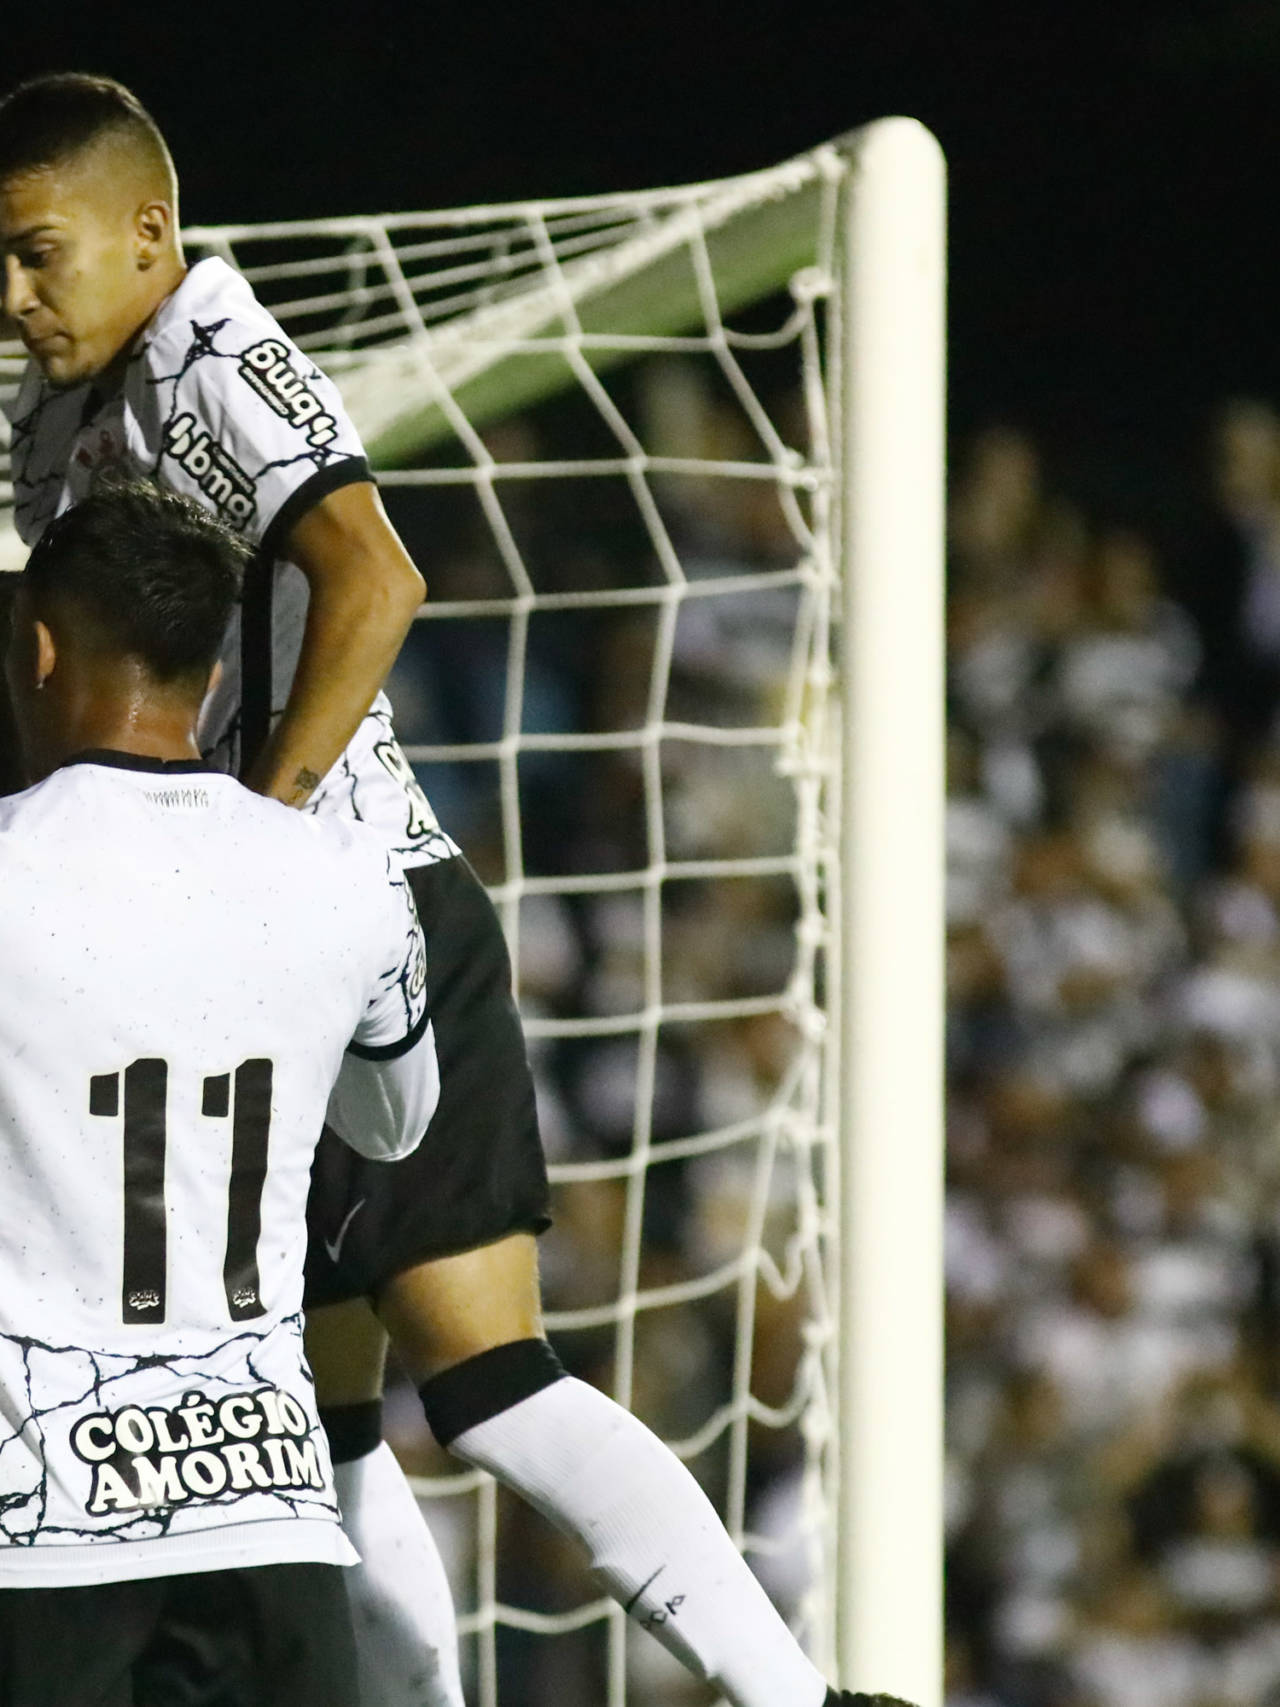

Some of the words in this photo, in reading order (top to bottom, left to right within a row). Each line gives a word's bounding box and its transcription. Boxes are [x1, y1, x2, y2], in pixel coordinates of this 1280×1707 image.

[245, 342, 322, 427] bmg
[90, 1058, 273, 1324] 11
[75, 1394, 308, 1462] COLÉGIO
[90, 1438, 324, 1513] AMORIM
